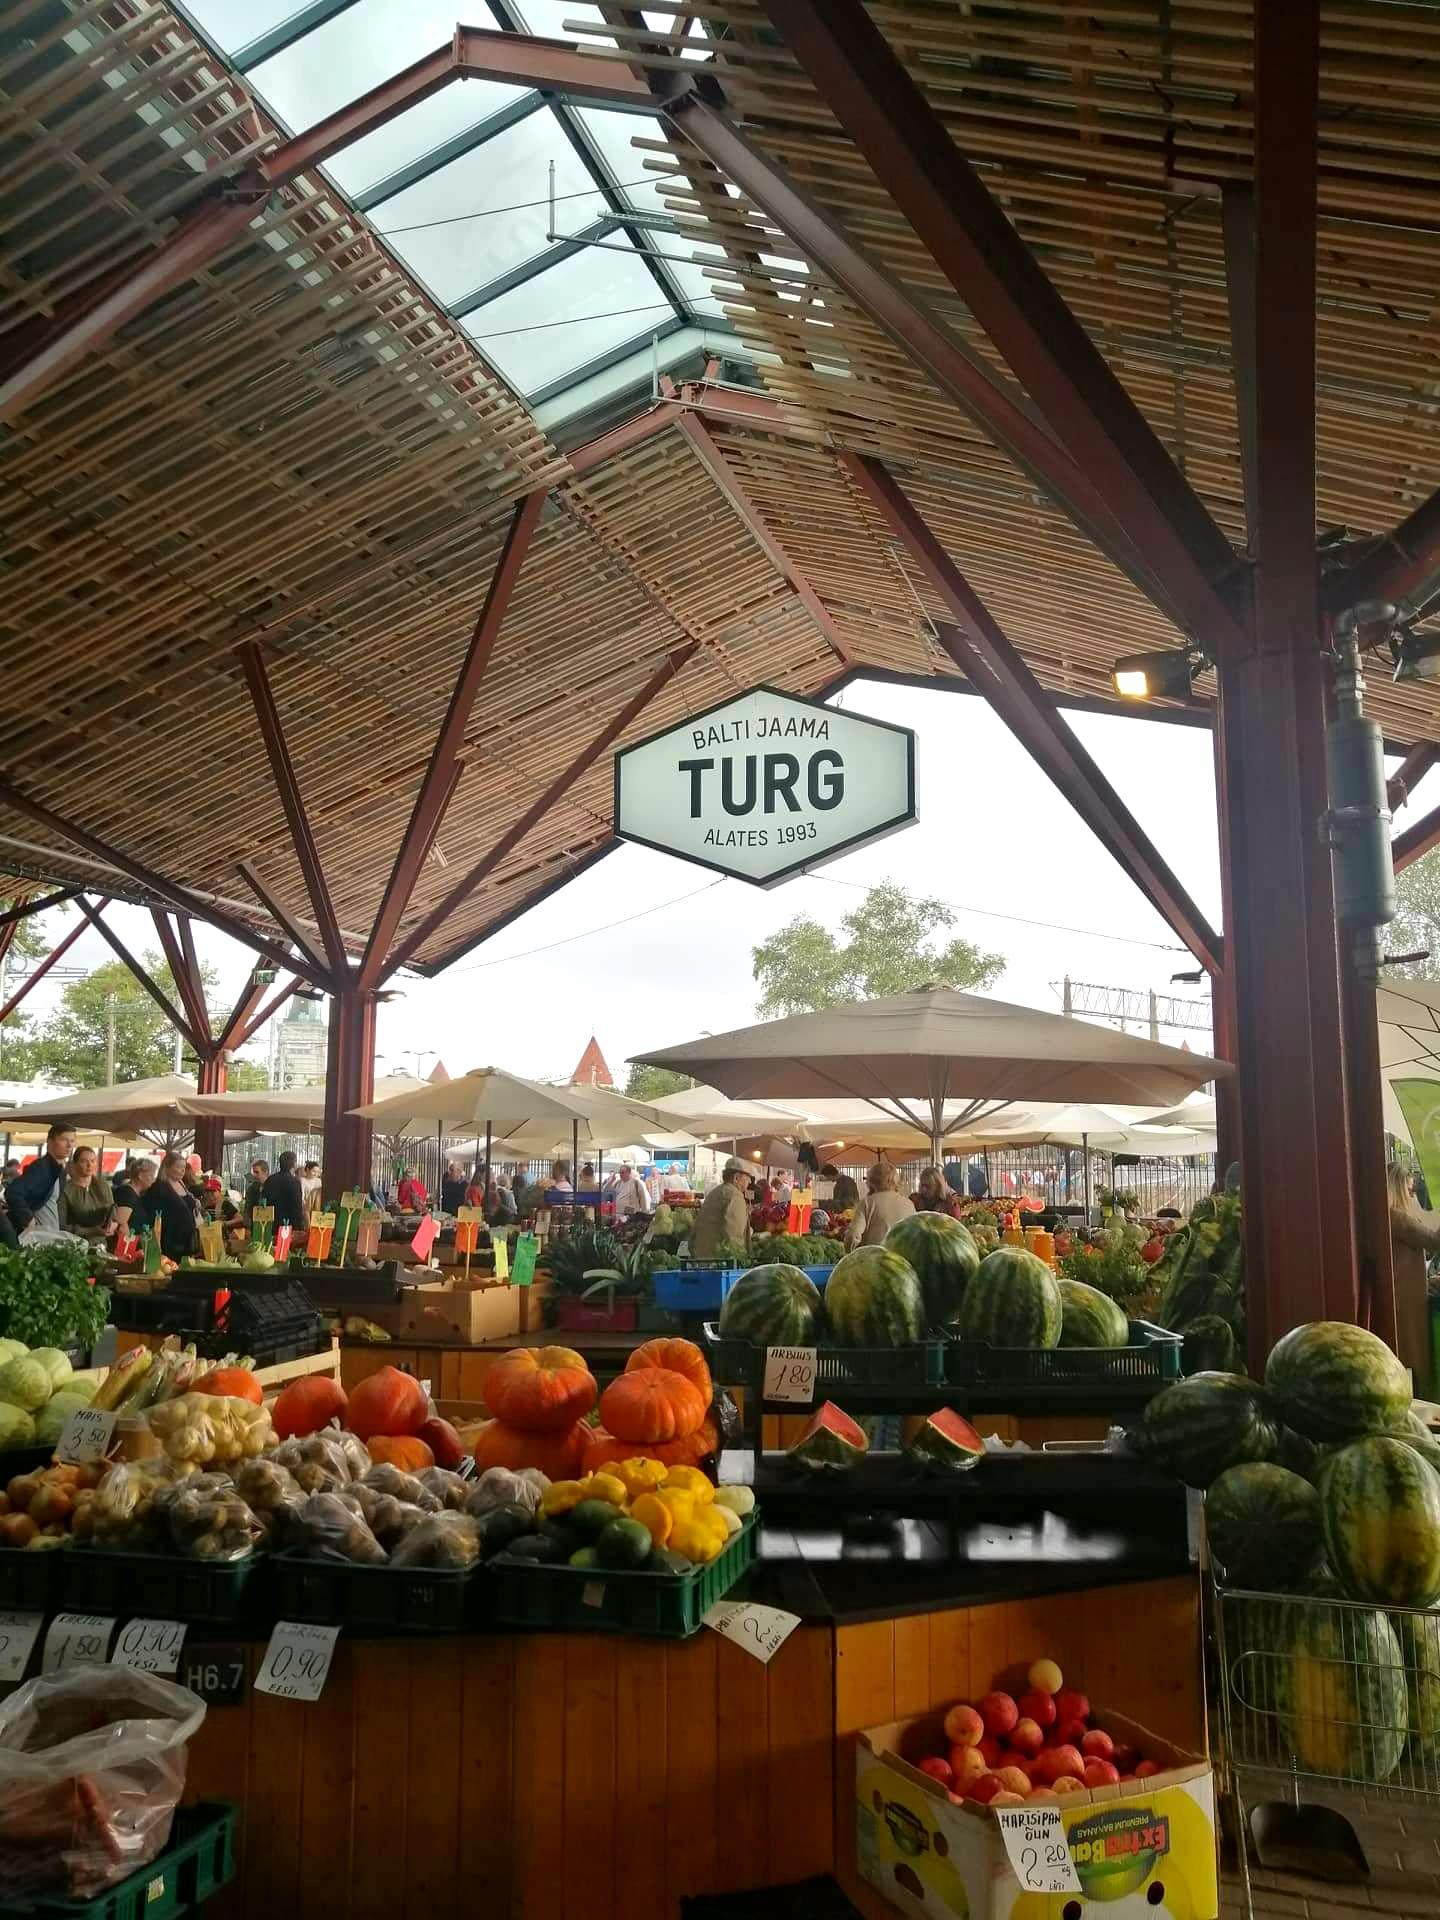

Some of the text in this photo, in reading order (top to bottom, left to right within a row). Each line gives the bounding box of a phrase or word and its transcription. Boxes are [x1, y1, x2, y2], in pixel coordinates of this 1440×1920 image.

[692, 717, 830, 750] BALTI JAAMA
[678, 748, 845, 819] TURG
[703, 822, 818, 847] ALATES 1993
[771, 1348, 812, 1361] ARBUUS
[187, 1663, 244, 1692] H6.7
[1076, 1815, 1150, 1839] PREMIUM BANANAS
